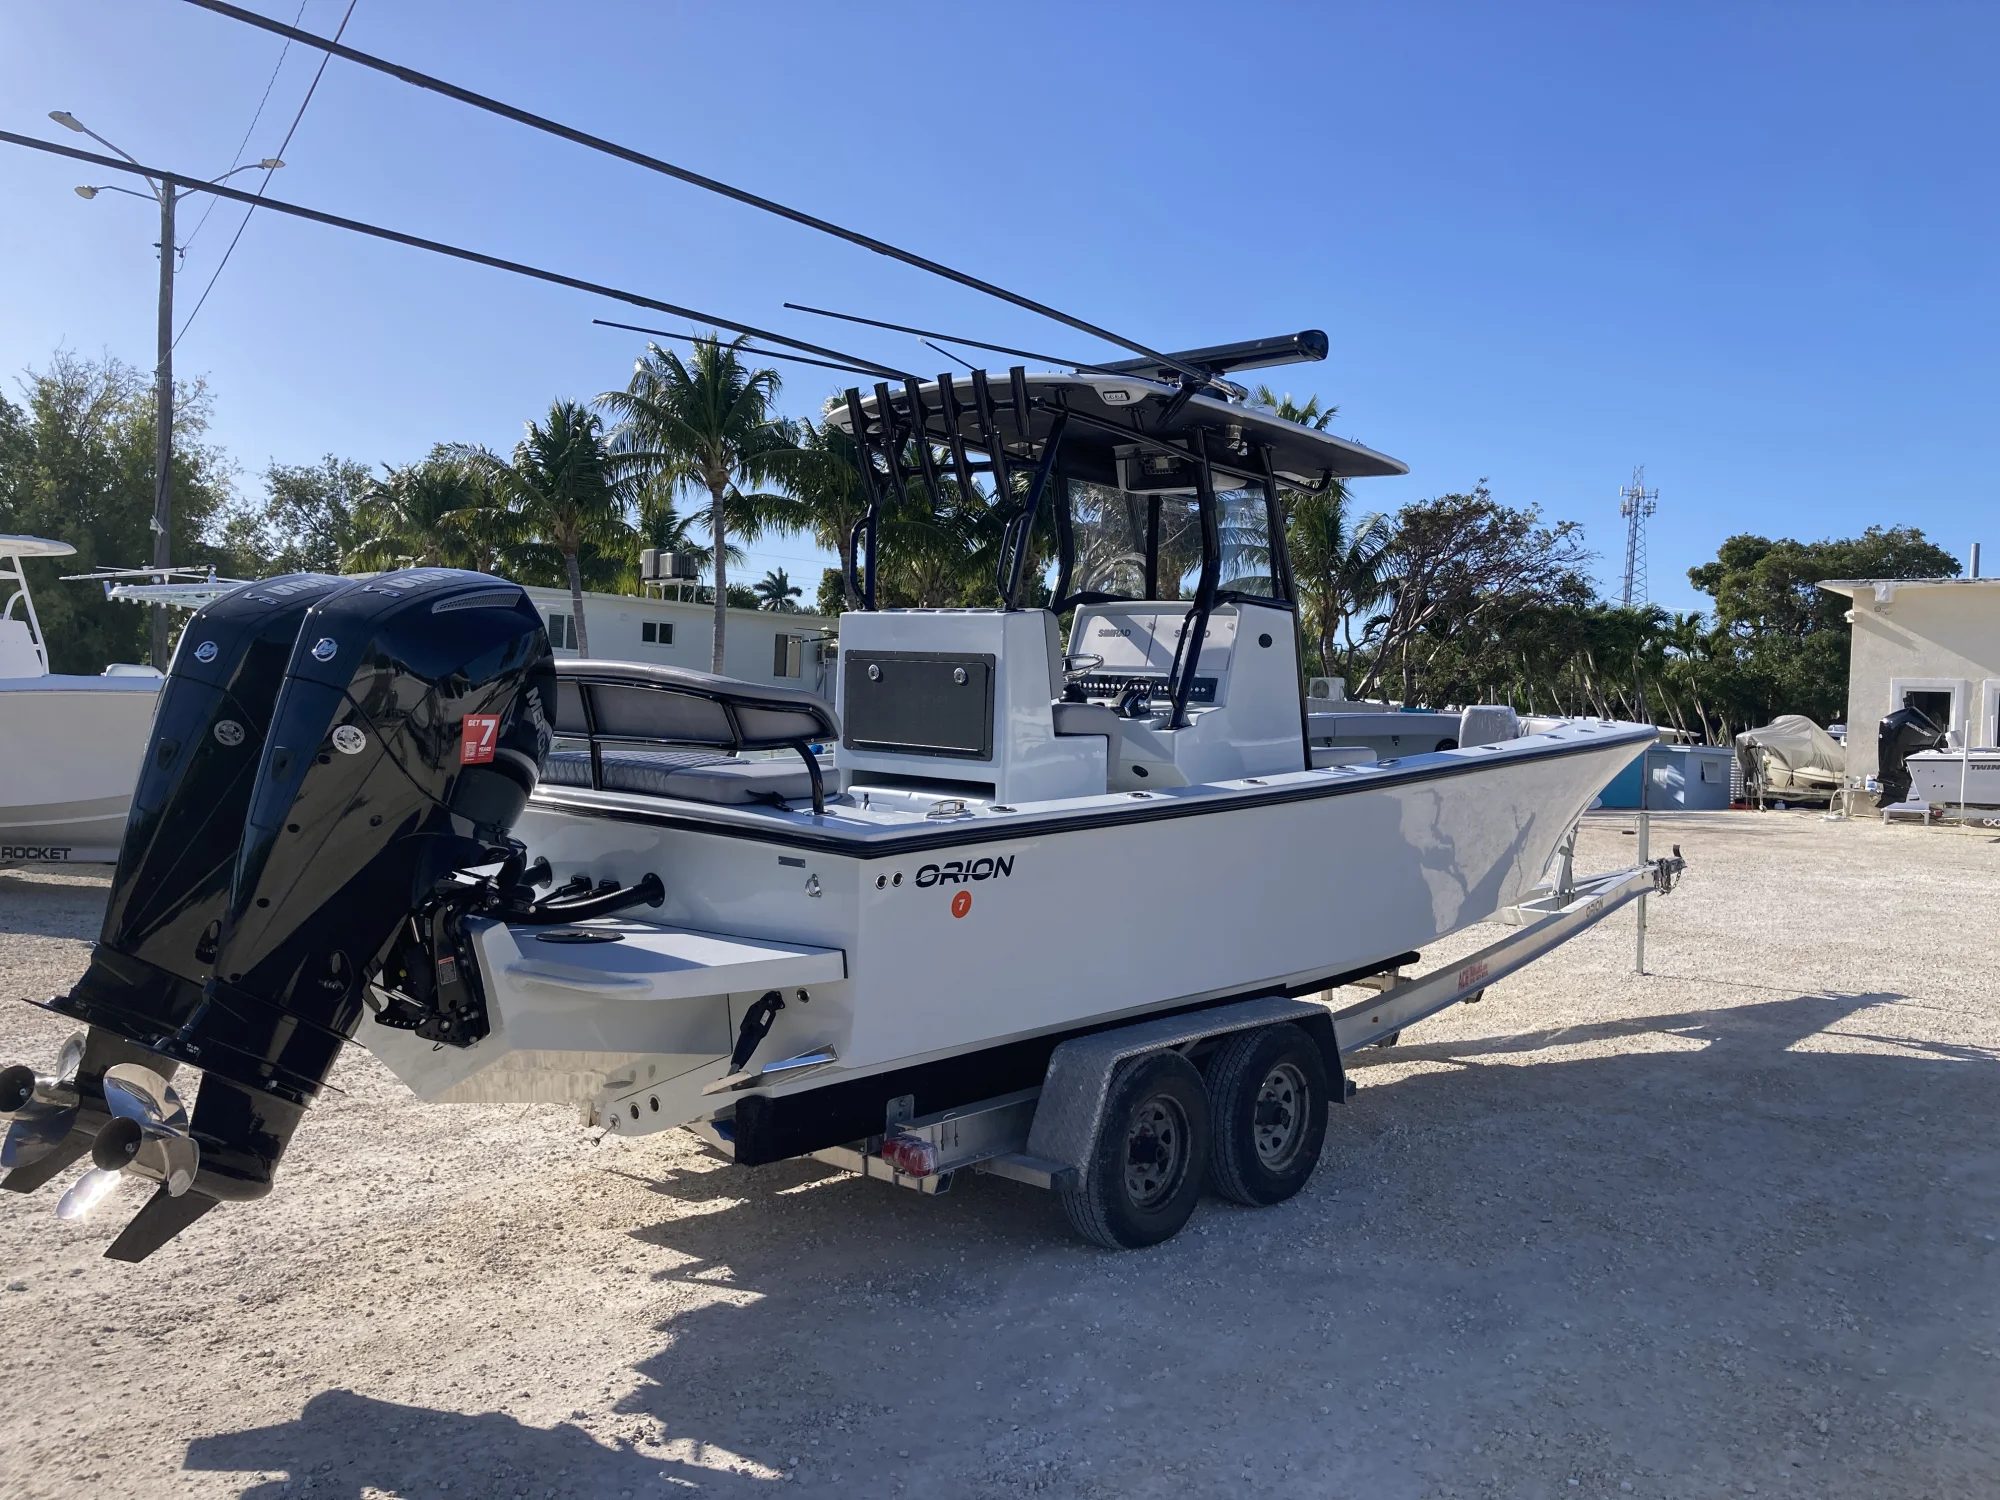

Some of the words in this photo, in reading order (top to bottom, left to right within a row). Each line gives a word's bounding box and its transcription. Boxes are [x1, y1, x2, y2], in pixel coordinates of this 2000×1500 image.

[1098, 629, 1131, 637] SIMRAD
[1174, 629, 1211, 638] SMD
[467, 719, 480, 727] GET
[480, 719, 496, 746] 7
[525, 686, 552, 764] MERCU
[1905, 721, 1932, 737] MERCURY
[1, 846, 72, 860] ROCKET
[914, 855, 1015, 888] ORION
[957, 898, 966, 911] 7
